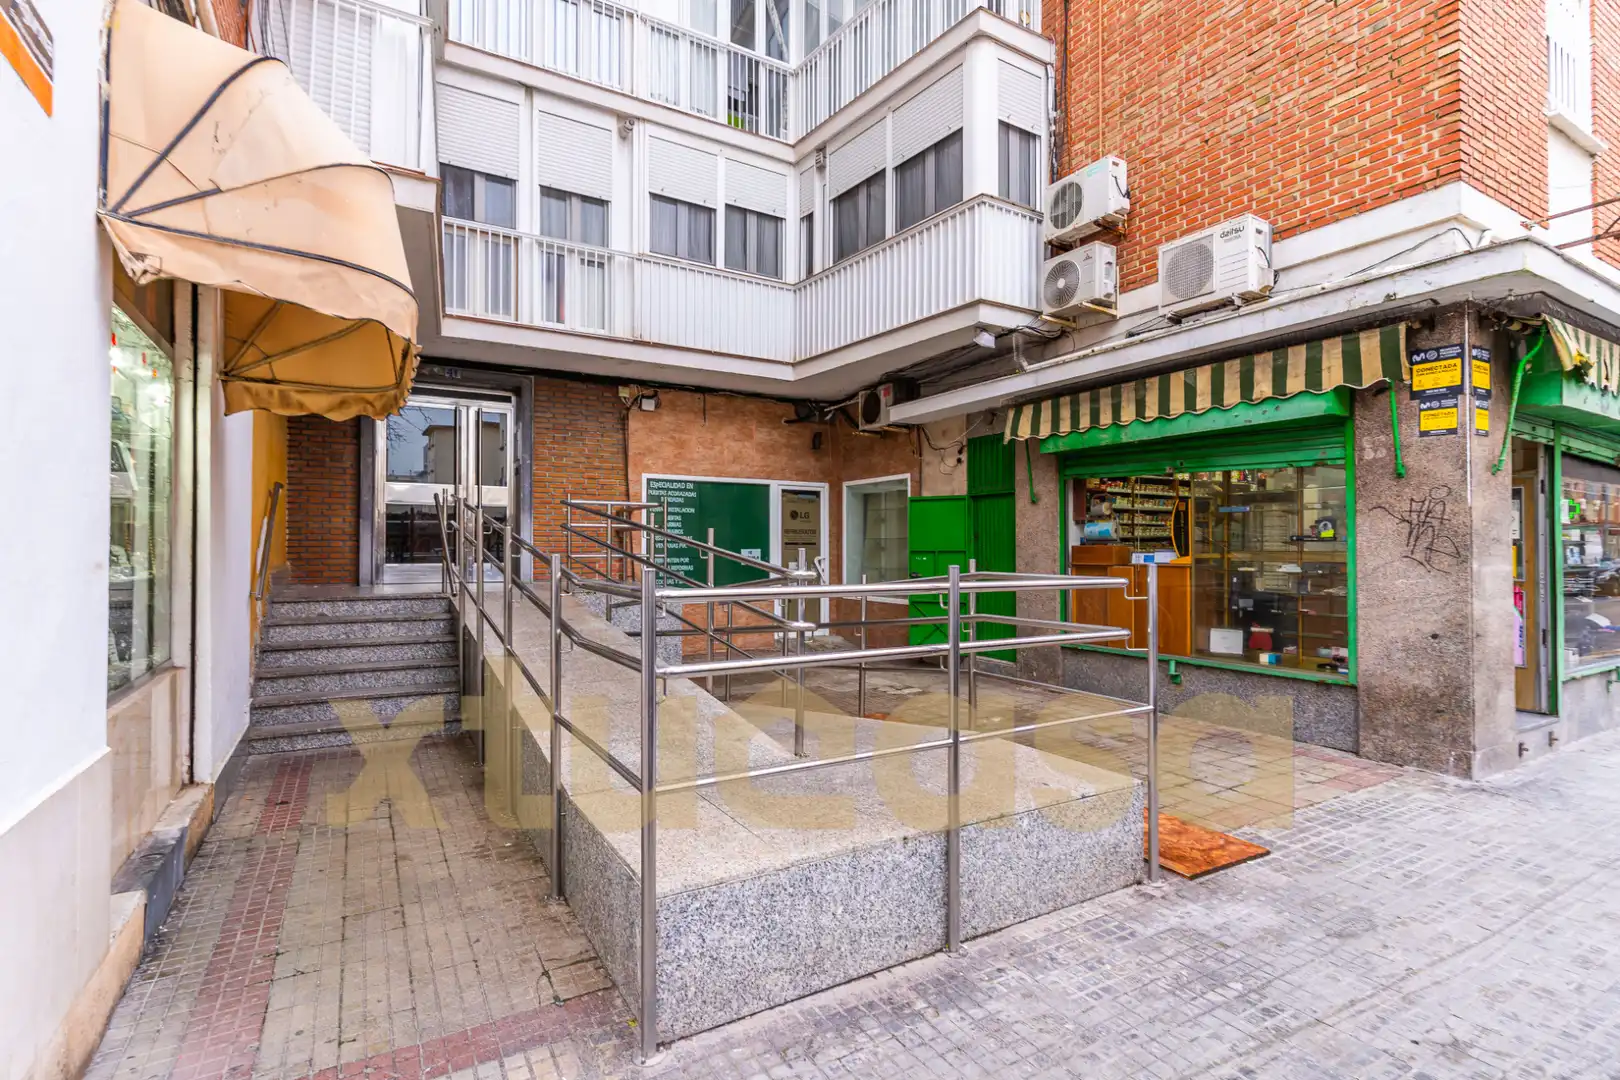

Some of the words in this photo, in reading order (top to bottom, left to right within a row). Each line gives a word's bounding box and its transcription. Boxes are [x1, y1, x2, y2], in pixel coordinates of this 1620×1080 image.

[1220, 225, 1245, 239] daitsu
[1415, 362, 1458, 374] CONECTADA
[650, 480, 686, 489] ESPECIALIDAD
[667, 490, 697, 498] ACORAZADAS
[799, 511, 810, 519] LG
